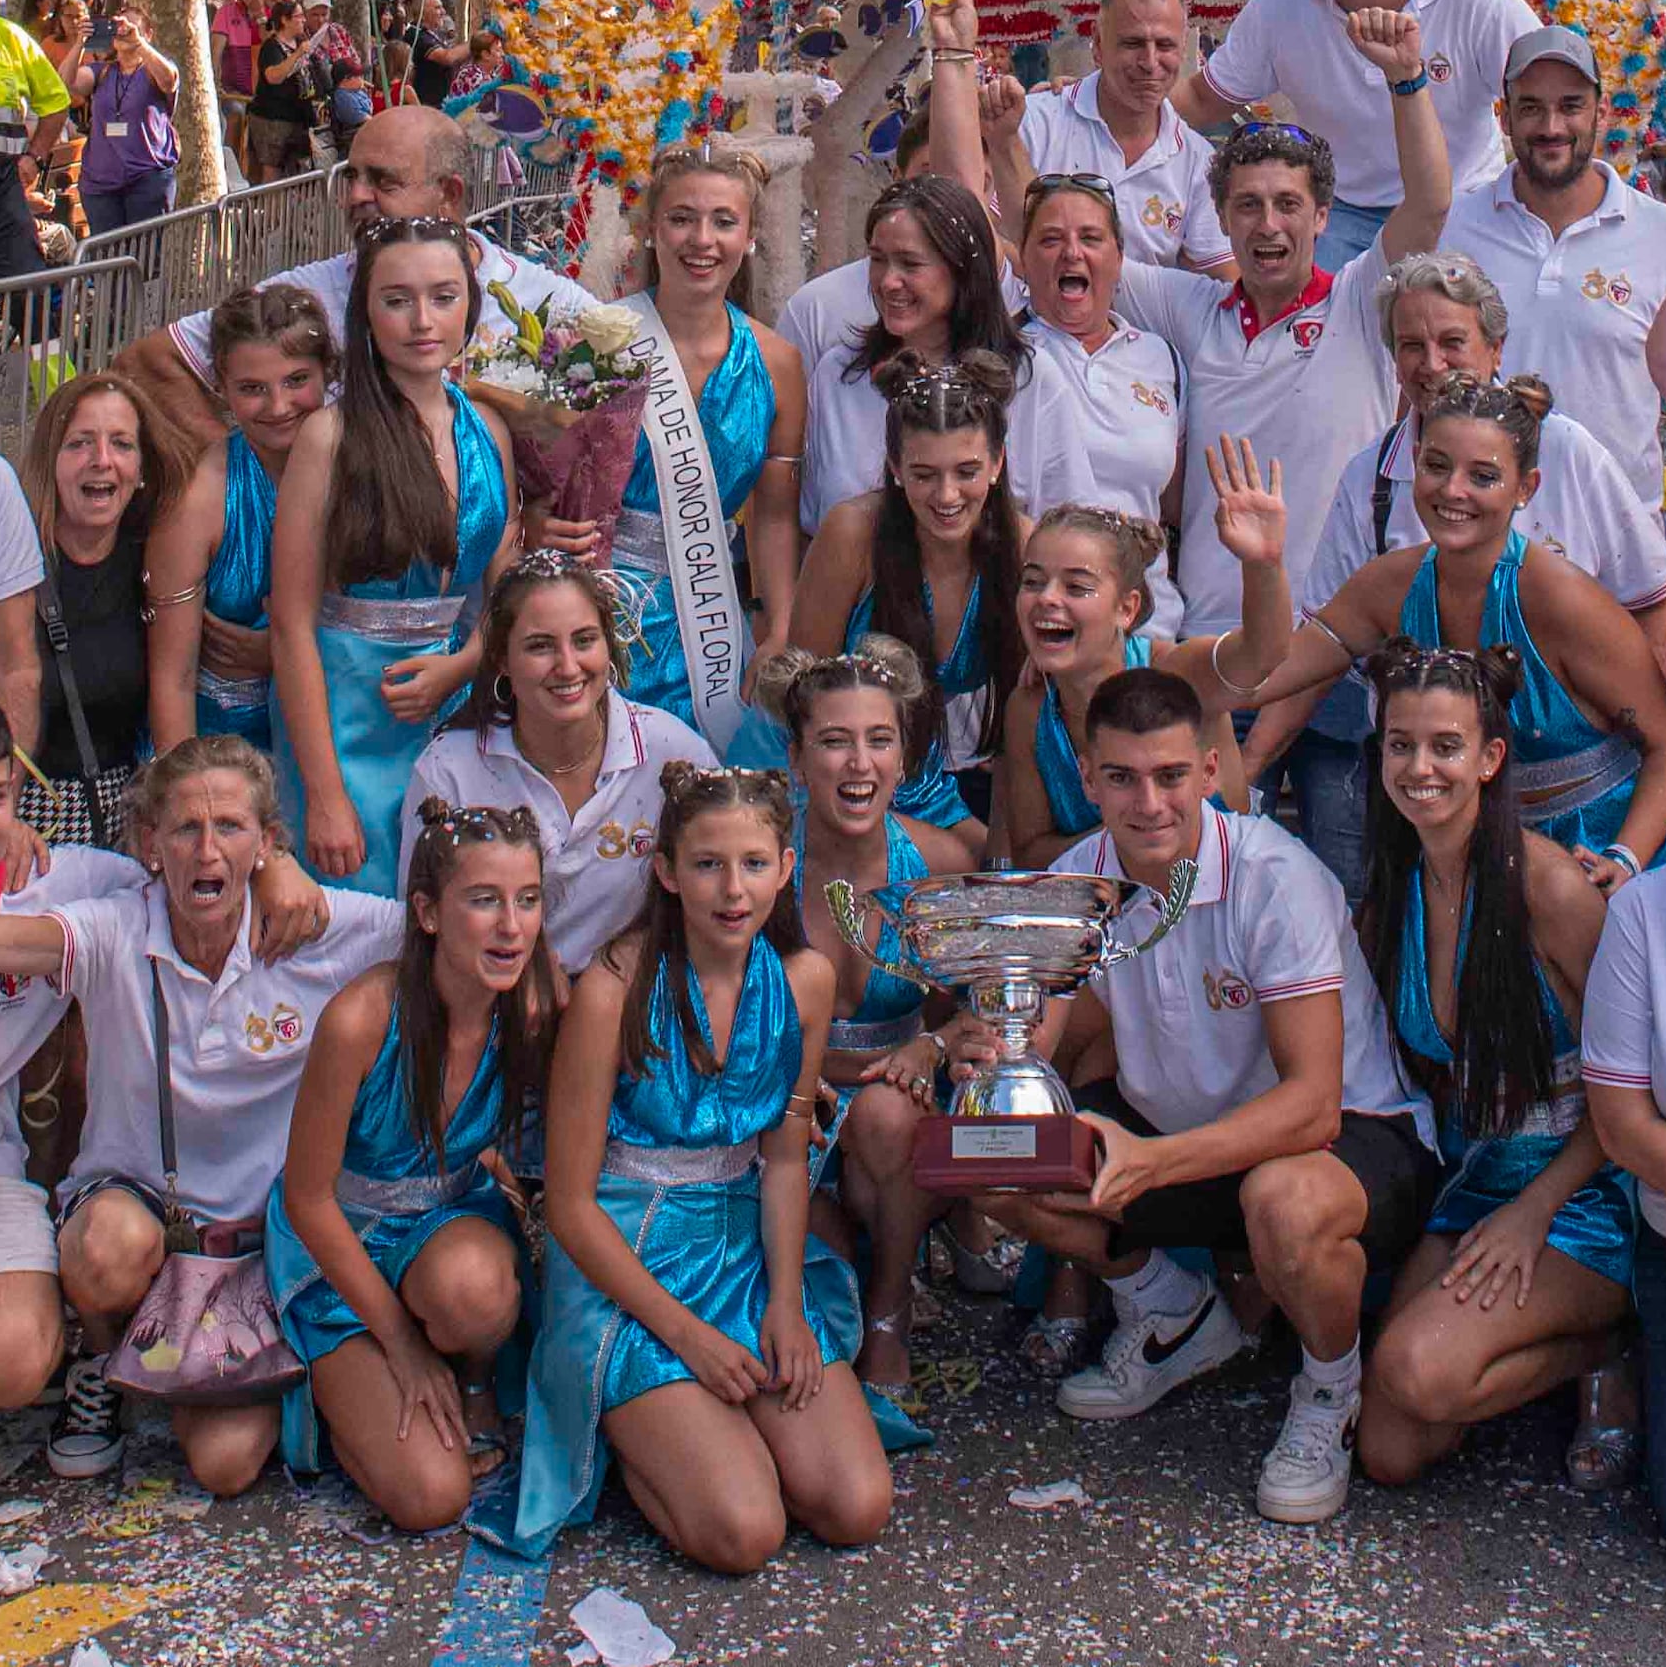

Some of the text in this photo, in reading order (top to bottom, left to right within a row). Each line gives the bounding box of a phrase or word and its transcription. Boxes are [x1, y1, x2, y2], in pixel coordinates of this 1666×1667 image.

[627, 336, 731, 707] DAMA DE HONOR GALA FLORAL
